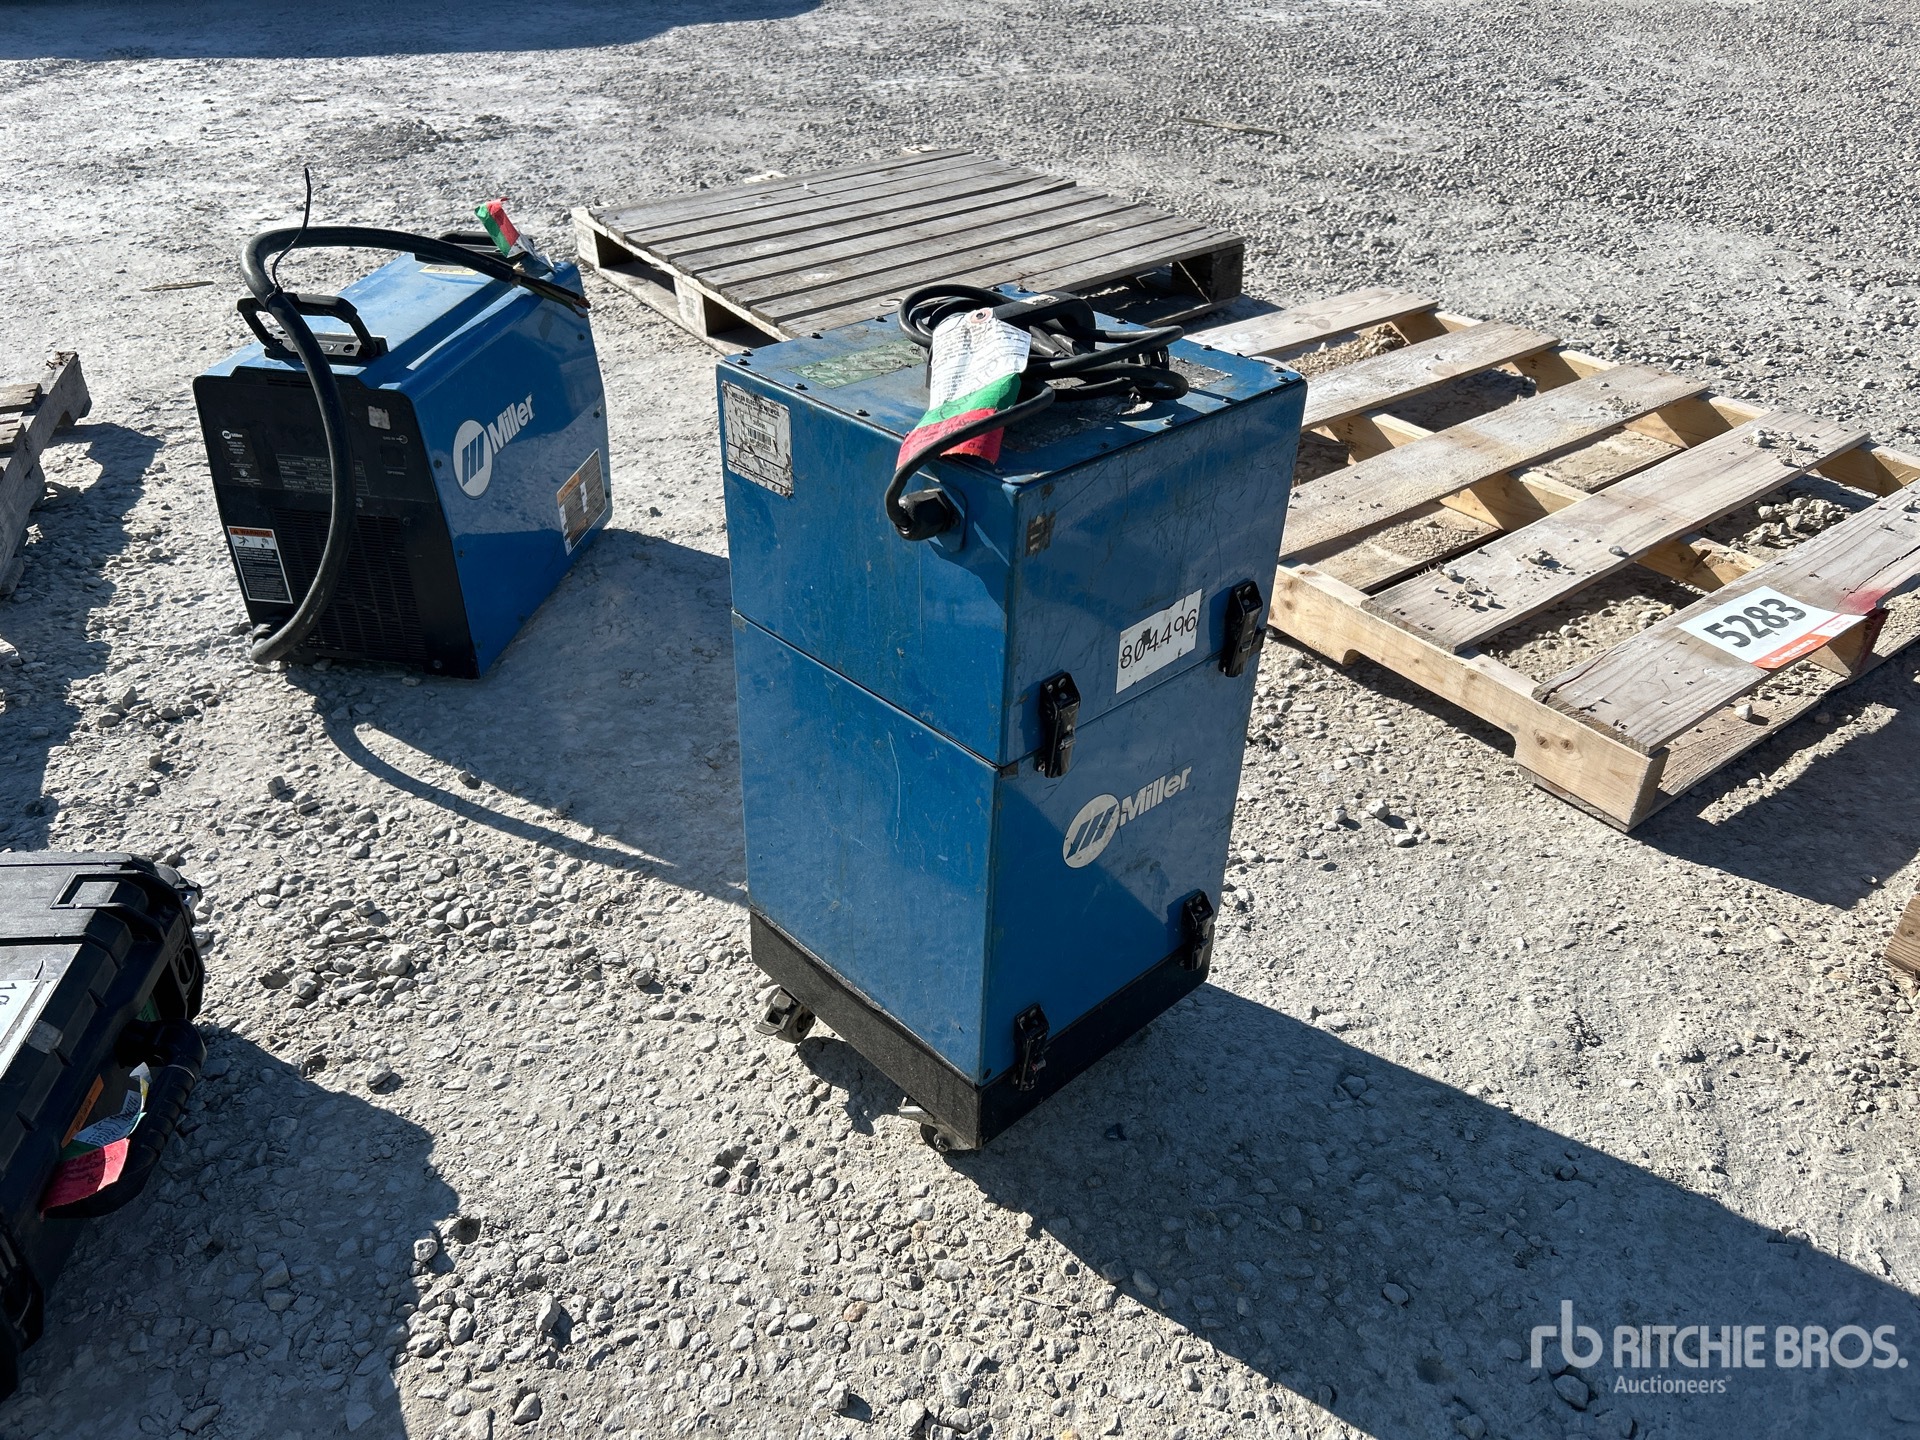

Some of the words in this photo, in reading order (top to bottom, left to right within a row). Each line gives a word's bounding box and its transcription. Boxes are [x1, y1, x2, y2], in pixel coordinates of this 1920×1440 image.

[487, 392, 534, 455] Miller
[1120, 608, 1198, 669] 804496
[1703, 598, 1807, 648] 5283
[1119, 766, 1193, 827] Miller
